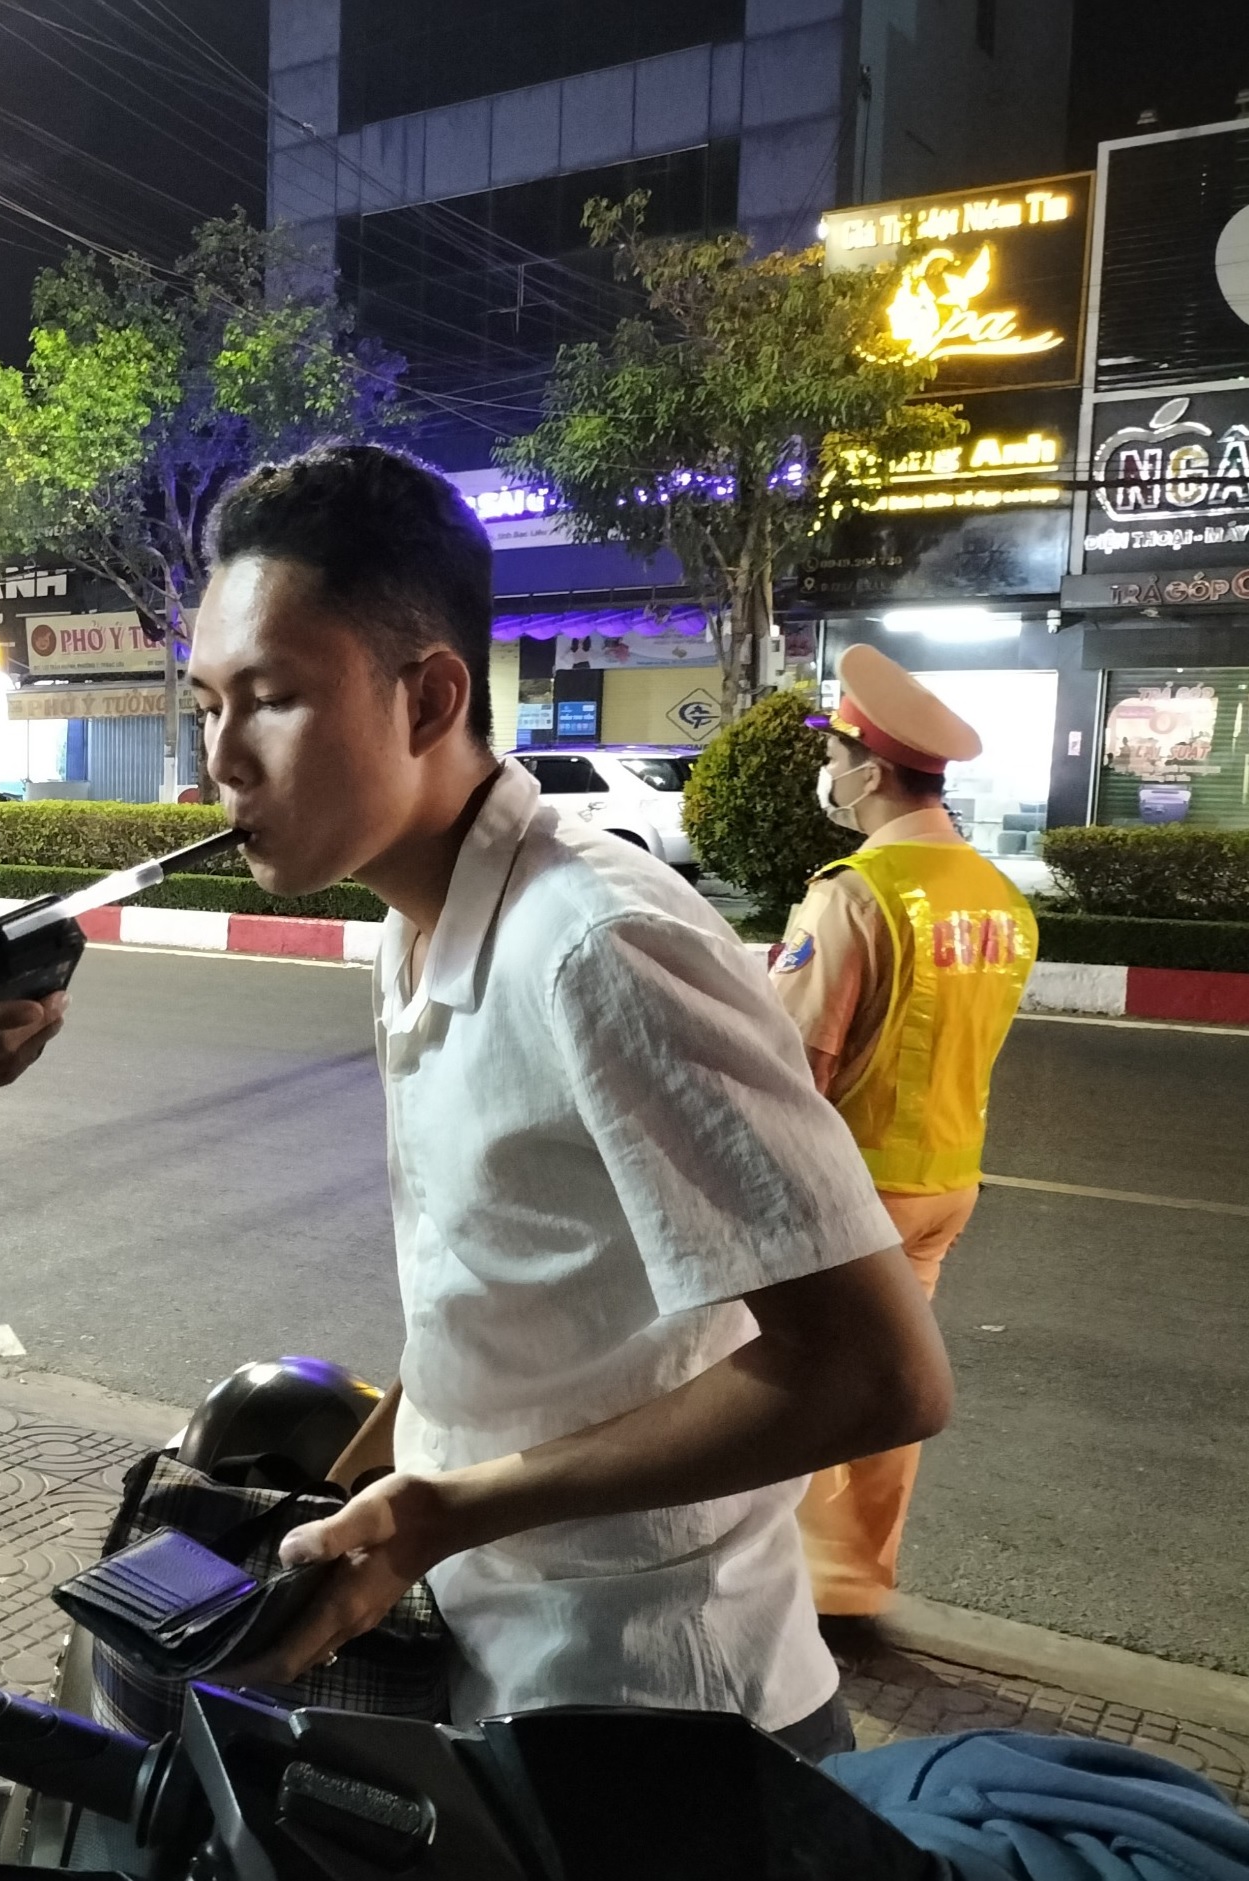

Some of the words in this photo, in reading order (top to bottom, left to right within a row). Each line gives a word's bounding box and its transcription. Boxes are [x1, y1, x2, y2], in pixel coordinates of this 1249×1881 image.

[1132, 529, 1193, 551] THOẠI
[1164, 571, 1230, 602] GÓP
[59, 620, 105, 654] PHỞ
[109, 621, 124, 651] Ý
